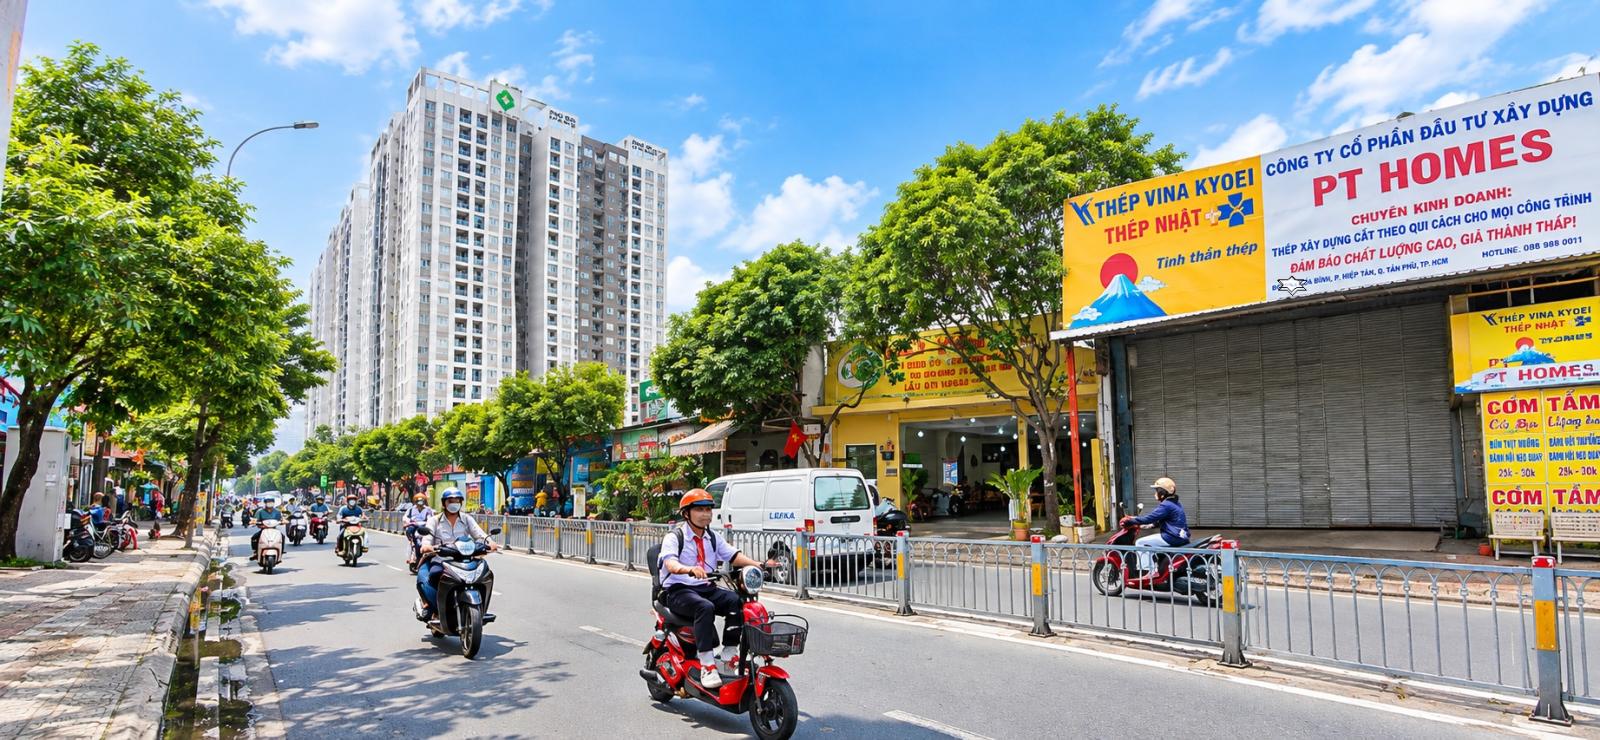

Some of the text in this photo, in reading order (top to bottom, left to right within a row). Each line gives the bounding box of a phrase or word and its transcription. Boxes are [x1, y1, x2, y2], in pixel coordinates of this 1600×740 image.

[1266, 158, 1309, 176] CÔNG
[1314, 148, 1334, 165] TY
[1462, 110, 1488, 131] TƯ
[1538, 90, 1593, 116] DỰNG
[1312, 128, 1553, 208] PT HOMES
[1094, 168, 1254, 218] THÉP VINA KYOEI
[1414, 198, 1448, 215] KINH
[1454, 187, 1512, 208] DOANH:
[1104, 208, 1202, 244] THÉP NHẬT
[1272, 243, 1298, 258] THÉP
[1300, 239, 1320, 252] XÂY
[1323, 234, 1351, 250] DỰNG
[1377, 225, 1406, 238] THEO
[1409, 220, 1428, 234] QUI
[1464, 210, 1488, 224] CHO
[1491, 206, 1513, 220] MỌI
[1517, 199, 1551, 214] CÔNG
[1426, 236, 1456, 251] CAO,
[1561, 236, 1583, 246] 0011
[1432, 258, 1448, 266] HCM
[1498, 306, 1592, 324] THÉP VINA KYOEI
[1504, 320, 1566, 333] THÉP NHẬT
[1519, 364, 1594, 381] HOMES
